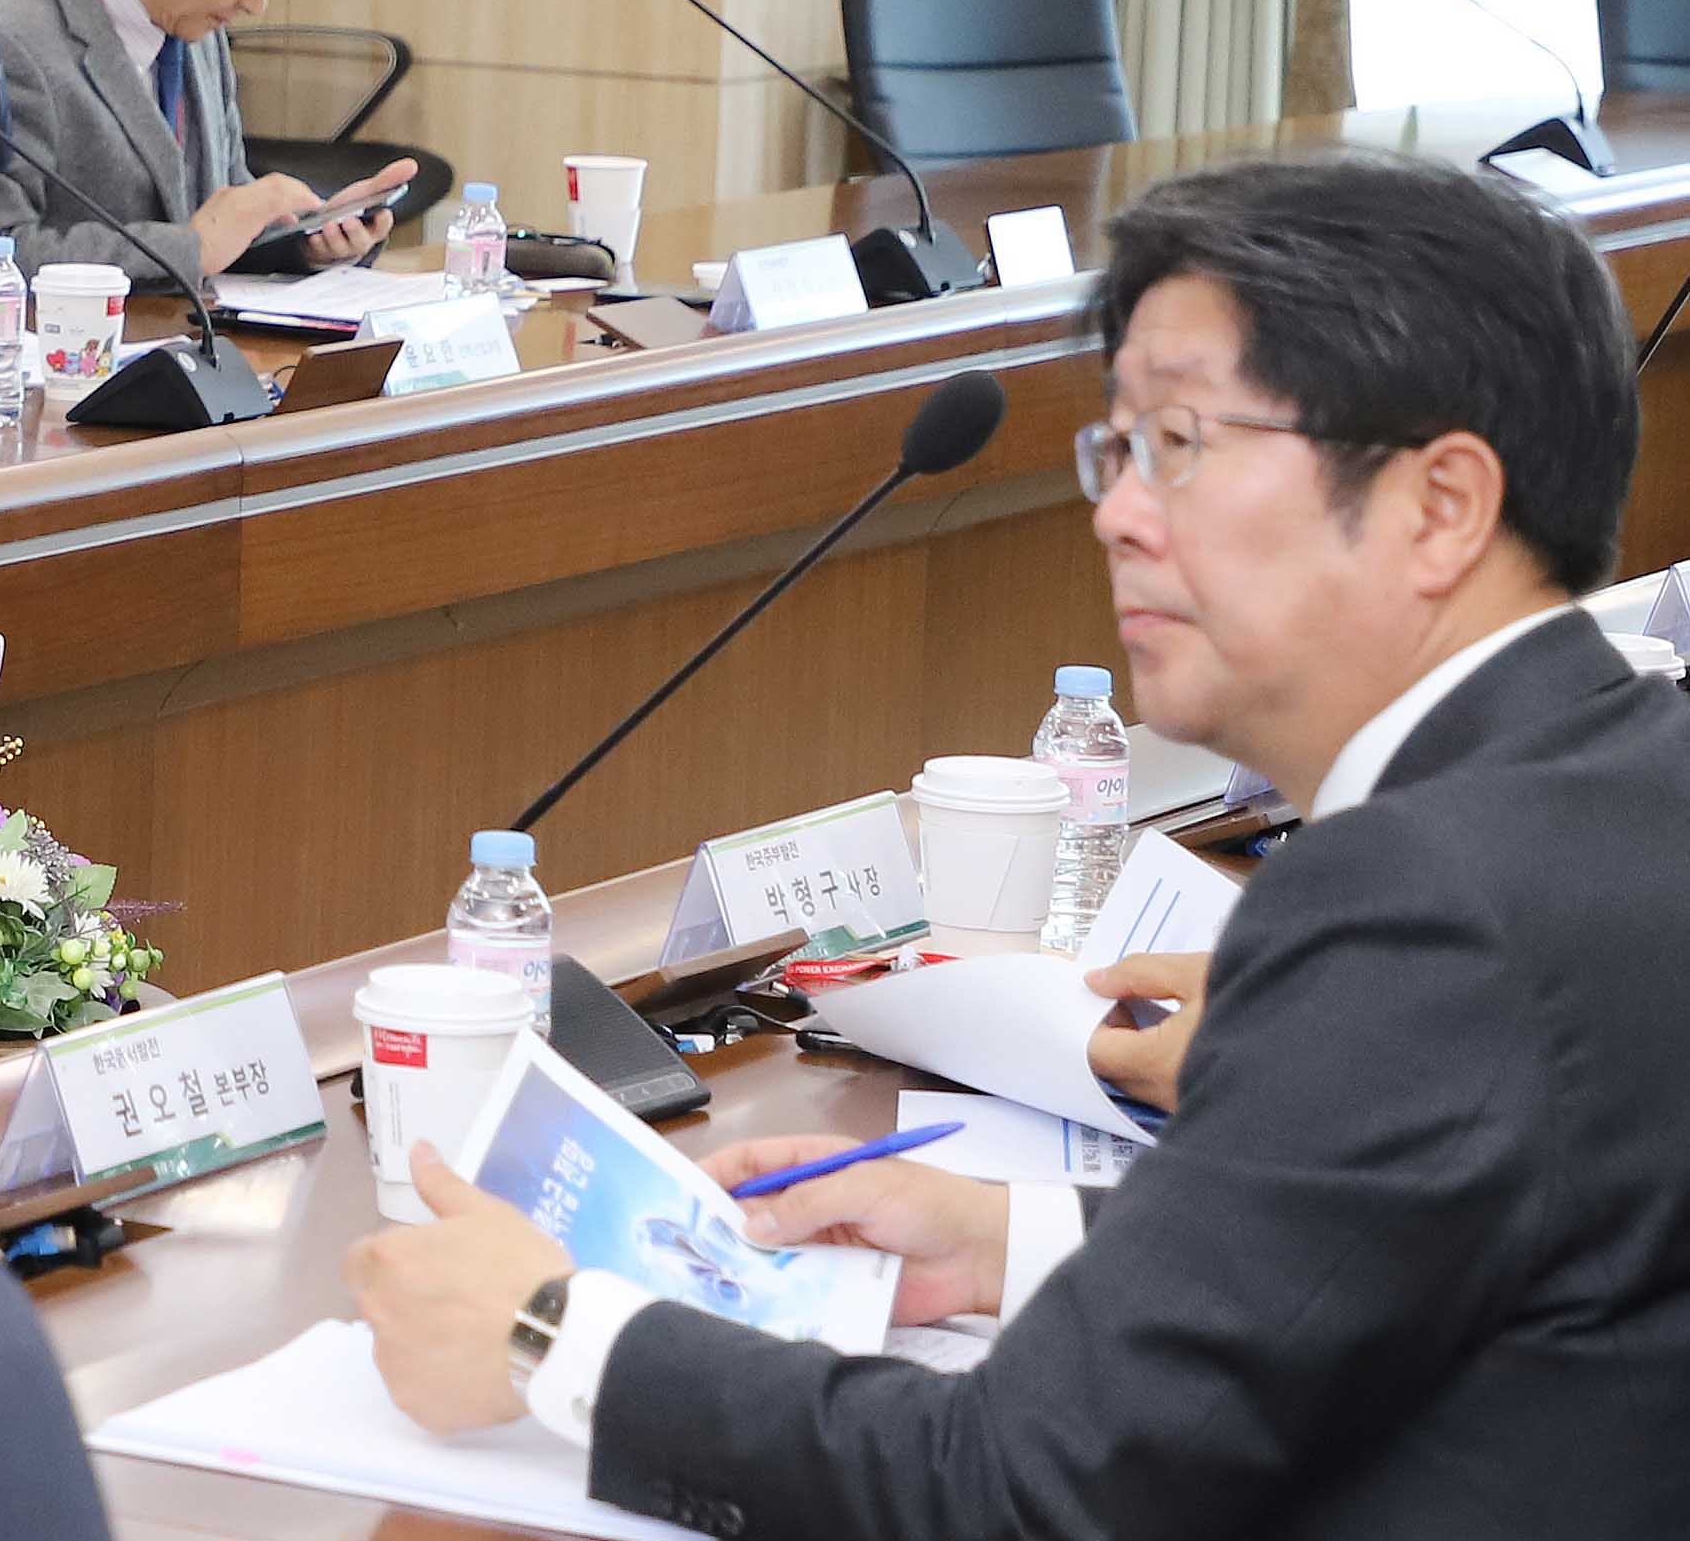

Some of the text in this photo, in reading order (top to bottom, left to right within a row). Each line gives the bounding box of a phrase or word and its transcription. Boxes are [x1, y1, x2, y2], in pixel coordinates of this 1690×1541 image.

[764, 869, 839, 925] 박형구
[112, 1059, 270, 1138] 권오철 본부장
